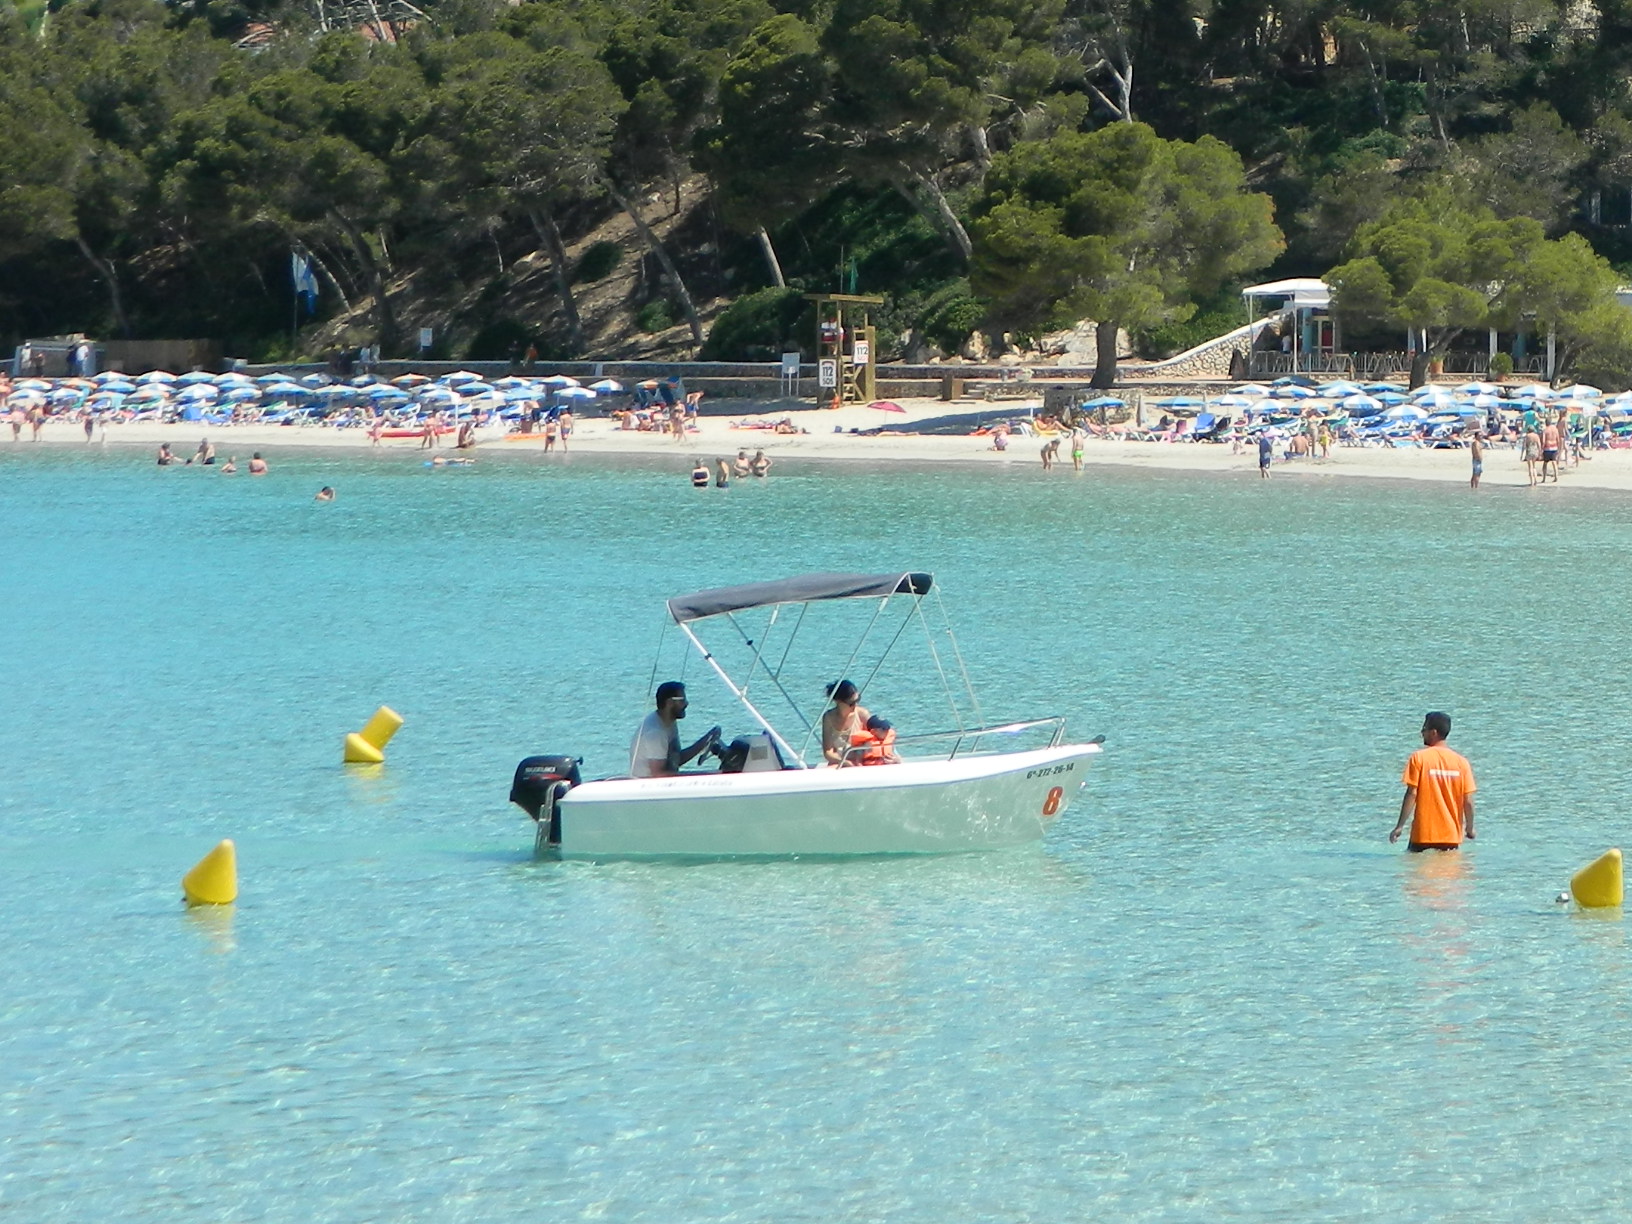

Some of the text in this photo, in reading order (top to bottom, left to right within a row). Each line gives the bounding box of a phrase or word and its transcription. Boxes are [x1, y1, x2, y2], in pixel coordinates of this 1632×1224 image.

[856, 346, 868, 355] 112
[822, 366, 834, 376] 112
[1042, 786, 1063, 815] 8
